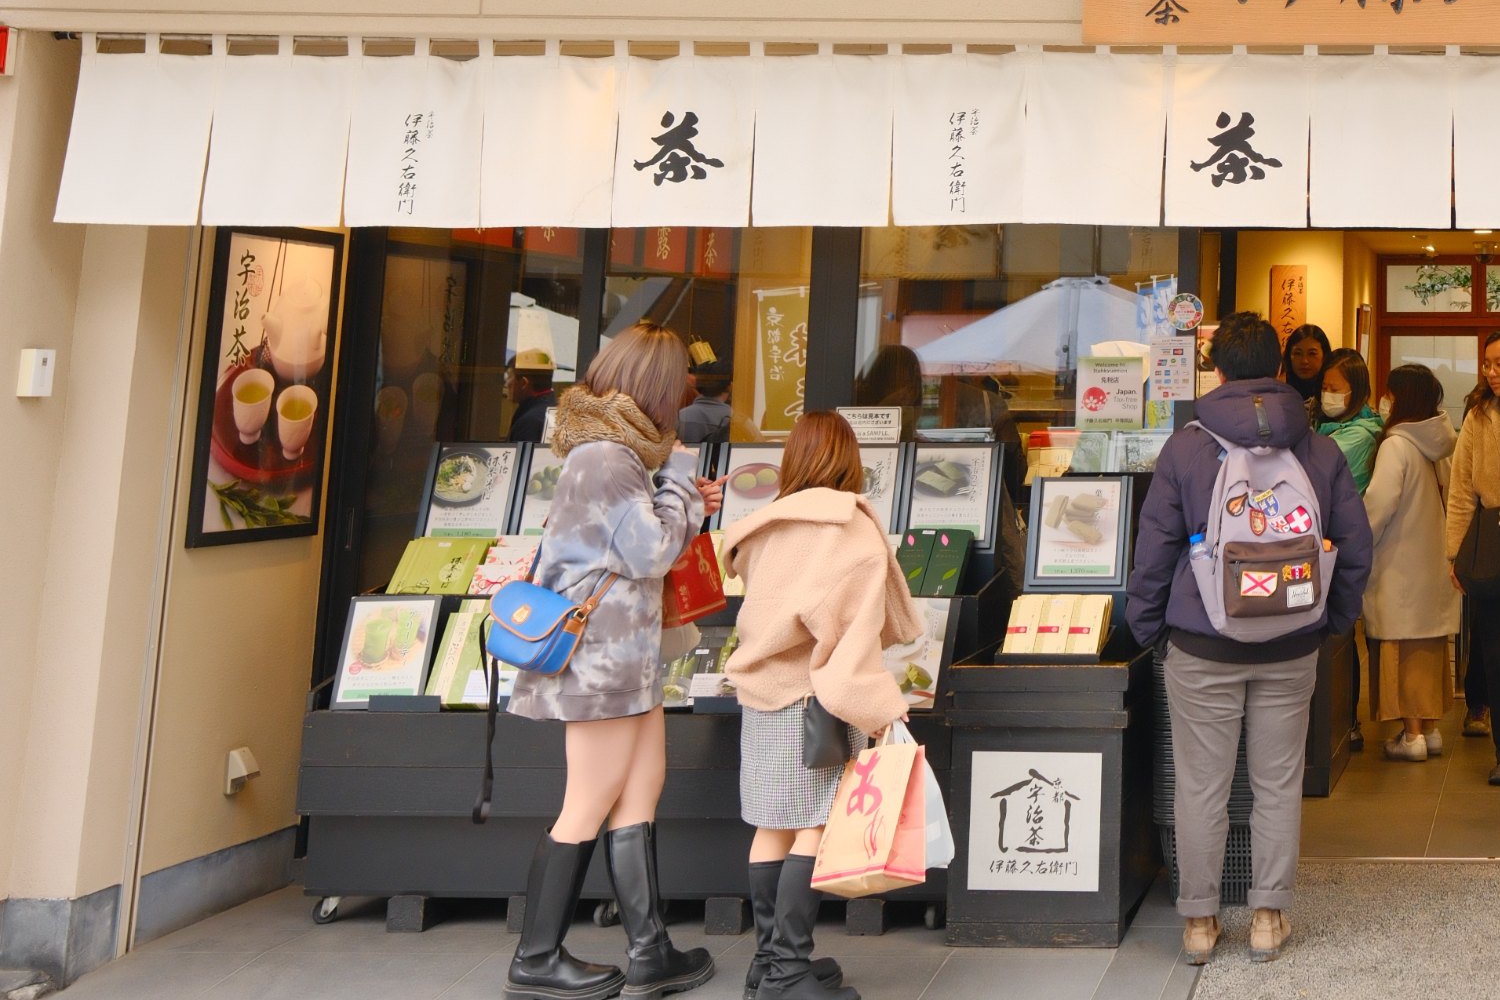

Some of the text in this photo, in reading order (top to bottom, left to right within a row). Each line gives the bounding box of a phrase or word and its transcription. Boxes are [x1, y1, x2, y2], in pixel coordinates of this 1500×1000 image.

[398, 113, 423, 215] 伊藤久右衛門
[633, 111, 724, 186] 茶
[949, 112, 966, 213] 伊藤久右衛門
[1190, 111, 1283, 187] 茶
[226, 249, 256, 367] 宇治茶
[1025, 784, 1045, 846] 宇治茶
[1053, 778, 1064, 803] 京都
[989, 860, 1078, 876] 伊藤久右衛門
